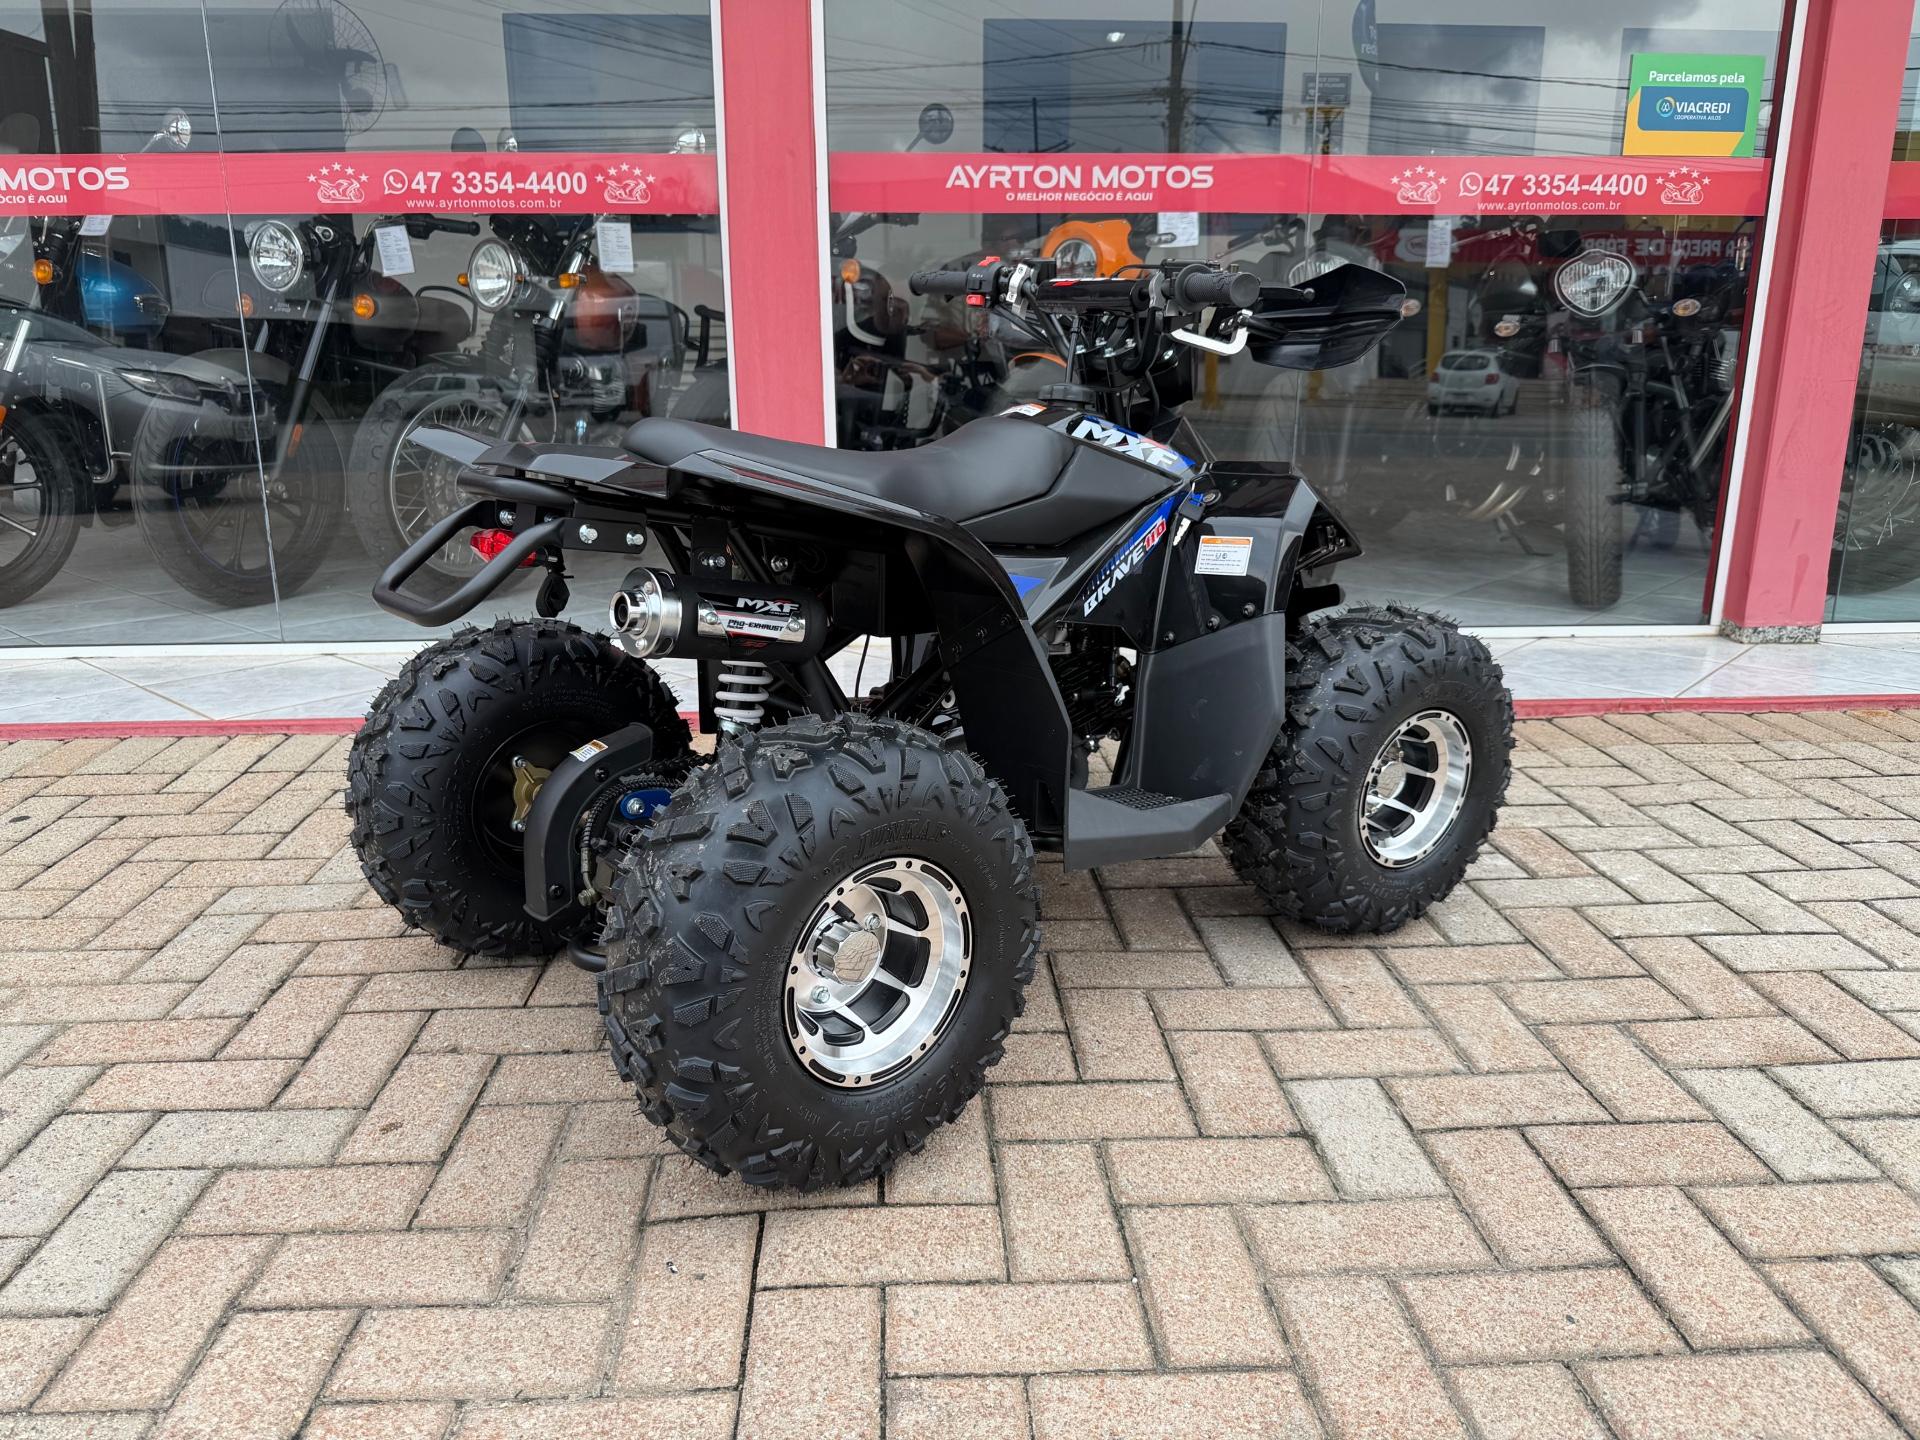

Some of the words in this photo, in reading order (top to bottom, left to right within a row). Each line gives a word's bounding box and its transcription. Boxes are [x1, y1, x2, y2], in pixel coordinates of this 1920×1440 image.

[1648, 70, 1717, 83] Parcelamos
[1719, 72, 1745, 86] pela
[1675, 101, 1731, 114] VIACREDI
[0, 166, 129, 191] MOTOS
[411, 171, 441, 194] 47
[452, 171, 587, 194] 3354-4400
[945, 165, 1081, 189] AYRTON
[1092, 165, 1214, 189] MOTOS
[1484, 173, 1515, 196] 47
[1522, 173, 1648, 196] 3354-4400
[28, 192, 35, 204] É
[37, 194, 67, 204] AQUI
[1006, 191, 1015, 201] O
[1016, 191, 1063, 201] MELHOR
[1064, 190, 1114, 201] NEGÓCIO
[1115, 190, 1123, 201] É
[1124, 191, 1153, 201] AQUI
[406, 198, 562, 210] www.ayrtonmotos.com.br
[1477, 200, 1621, 212] www.ayrtonmotos.com.br
[1071, 419, 1178, 466] MXF
[1084, 542, 1145, 617] BRAVE
[736, 597, 800, 614] MXF
[727, 619, 784, 632] PRO-EXHAUST
